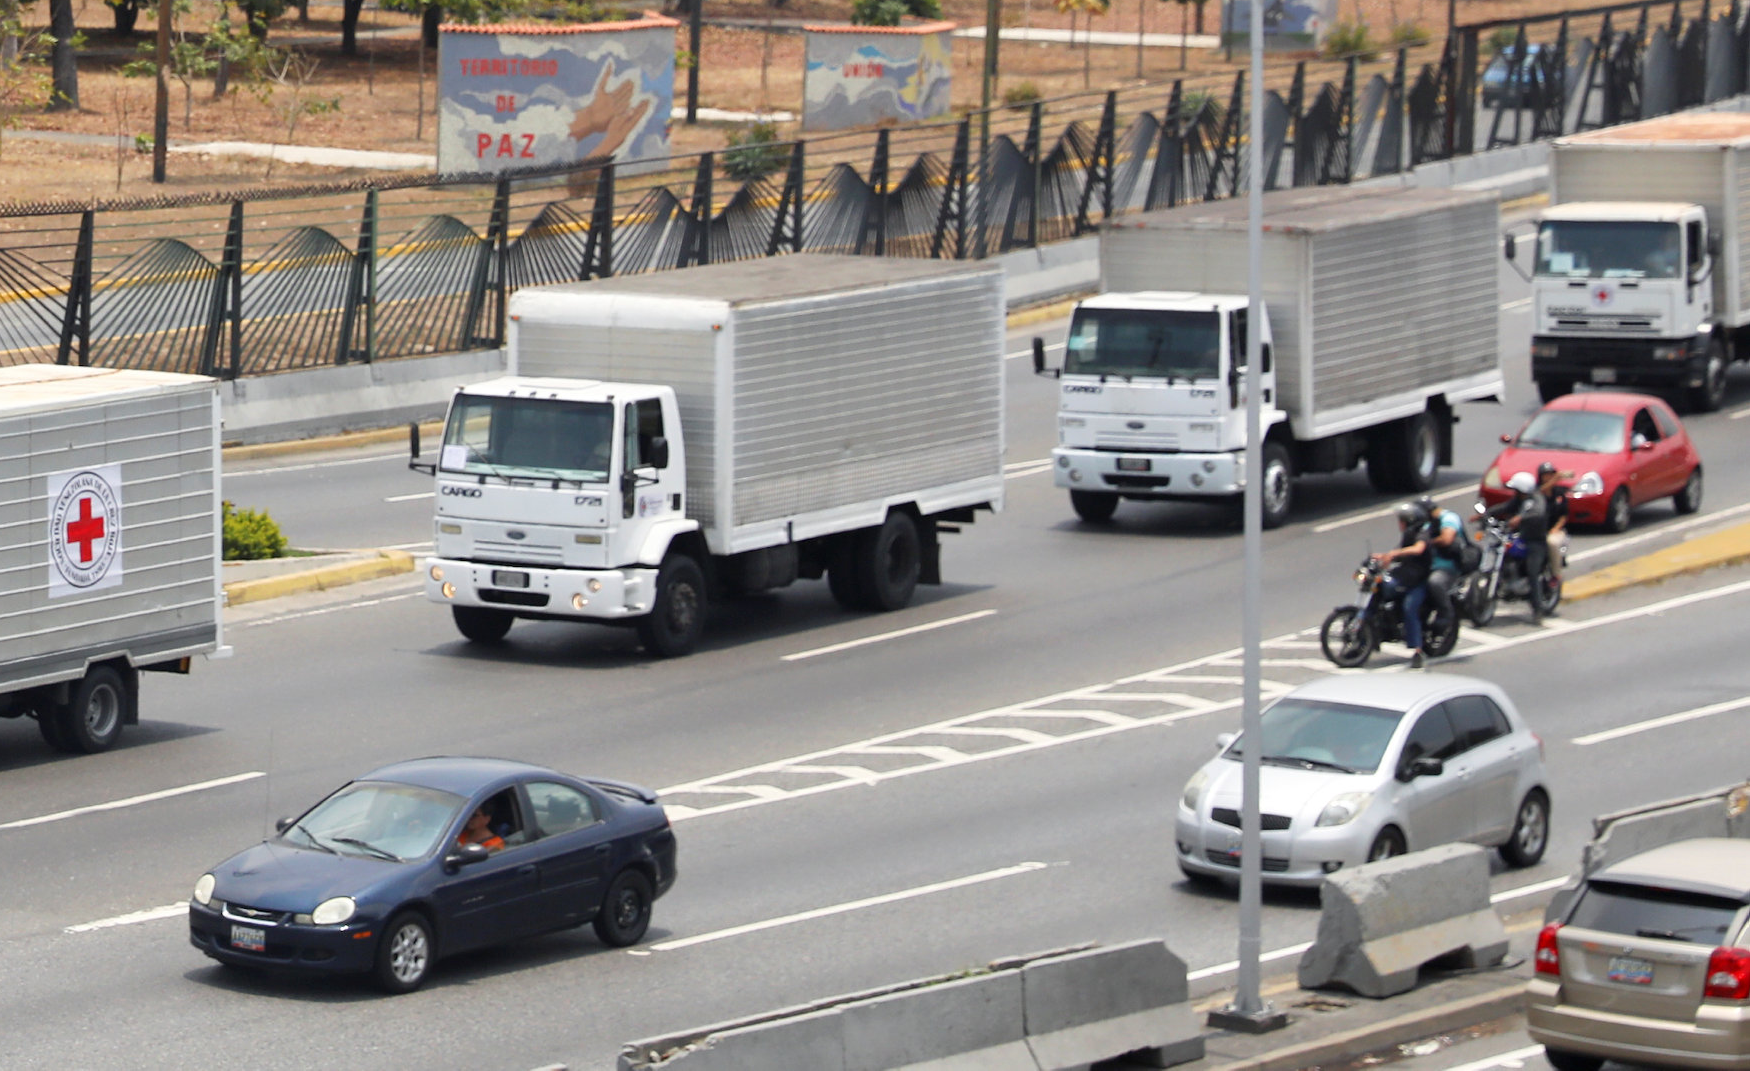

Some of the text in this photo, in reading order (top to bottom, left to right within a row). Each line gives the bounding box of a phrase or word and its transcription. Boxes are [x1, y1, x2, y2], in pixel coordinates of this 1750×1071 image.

[459, 57, 559, 77] TERRITORIO
[495, 94, 517, 114] DE
[476, 132, 536, 159] PAZ
[441, 485, 483, 499] CARGO
